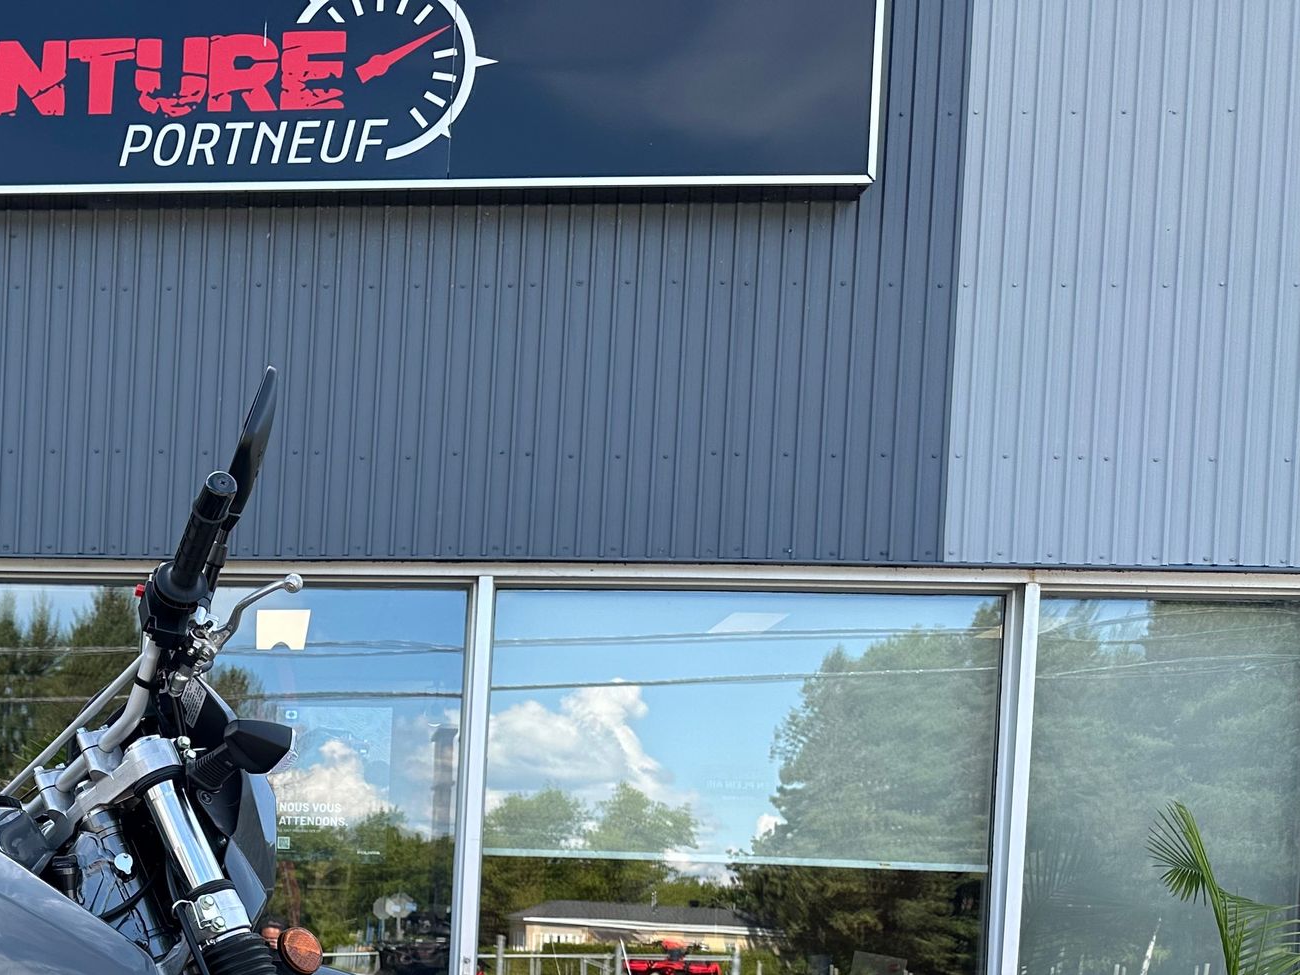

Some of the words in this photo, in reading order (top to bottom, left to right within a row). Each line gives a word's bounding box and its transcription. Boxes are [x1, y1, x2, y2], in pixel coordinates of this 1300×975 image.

[118, 118, 389, 167] PORTNEUF
[279, 801, 310, 813] NOUS
[313, 802, 342, 814] VOUS
[278, 815, 349, 827] ATTENDONS.
